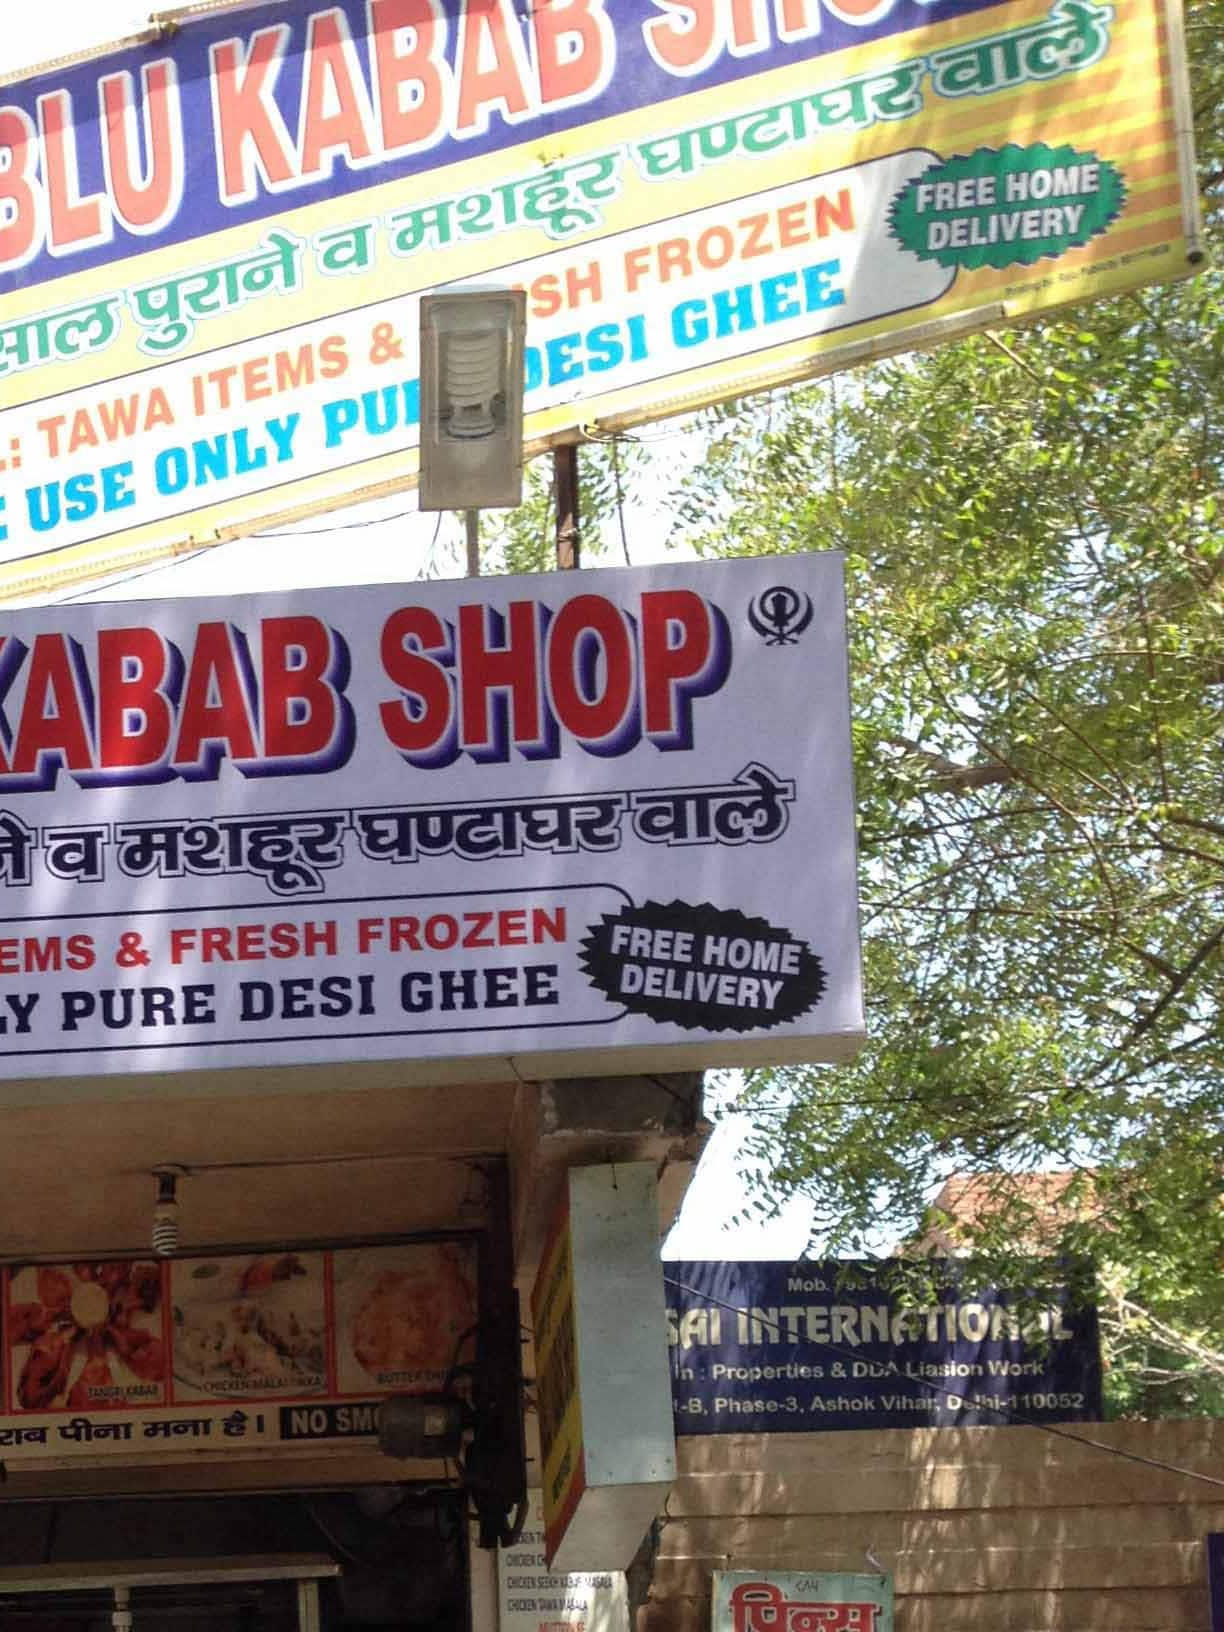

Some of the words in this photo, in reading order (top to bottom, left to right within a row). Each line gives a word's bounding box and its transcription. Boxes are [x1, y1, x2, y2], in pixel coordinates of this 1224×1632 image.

[210, 0, 616, 207] KABAB
[131, 231, 303, 353] पुराने
[321, 223, 374, 271] व
[638, 60, 922, 178] घण्टाघर
[933, 3, 1112, 95] वाले
[916, 176, 996, 213] FREE
[1006, 163, 1099, 202] HOME
[927, 204, 1085, 250] DELIVERY
[38, 387, 175, 459] TAWA
[192, 336, 349, 417] ITEMS
[368, 321, 405, 364] &
[623, 187, 856, 292] FROZEN
[26, 462, 136, 532] USE
[155, 413, 300, 495] ONLY
[324, 379, 421, 448] PU
[671, 258, 845, 349] GHEE
[378, 588, 728, 767] SHOP
[43, 826, 104, 882] व
[113, 813, 346, 895] मशहूर
[353, 796, 626, 864] घण्टाघर
[630, 761, 796, 847] वाले
[115, 931, 148, 967] &
[170, 919, 337, 965] FRESH
[357, 907, 568, 956] FROZEN
[610, 923, 693, 965] FREE
[703, 933, 802, 977] HOME
[61, 983, 217, 1034] PURE
[240, 974, 374, 1022] DESI
[401, 965, 559, 1012] GHEE
[620, 962, 784, 1012] DELIVERY
[787, 1277, 830, 1292] Mob.
[202, 1379, 251, 1392] CHICKEN
[712, 1363, 824, 1383] Properties
[831, 1363, 847, 1378] &
[853, 1361, 899, 1377] DDA
[906, 1359, 983, 1377] Liasion
[989, 1359, 1045, 1376] Work
[58, 1418, 132, 1443] पीना
[144, 1418, 211, 1440] मना
[290, 1408, 328, 1434] NO
[714, 1396, 805, 1415] Phase-3,
[811, 1394, 875, 1411] Ashok
